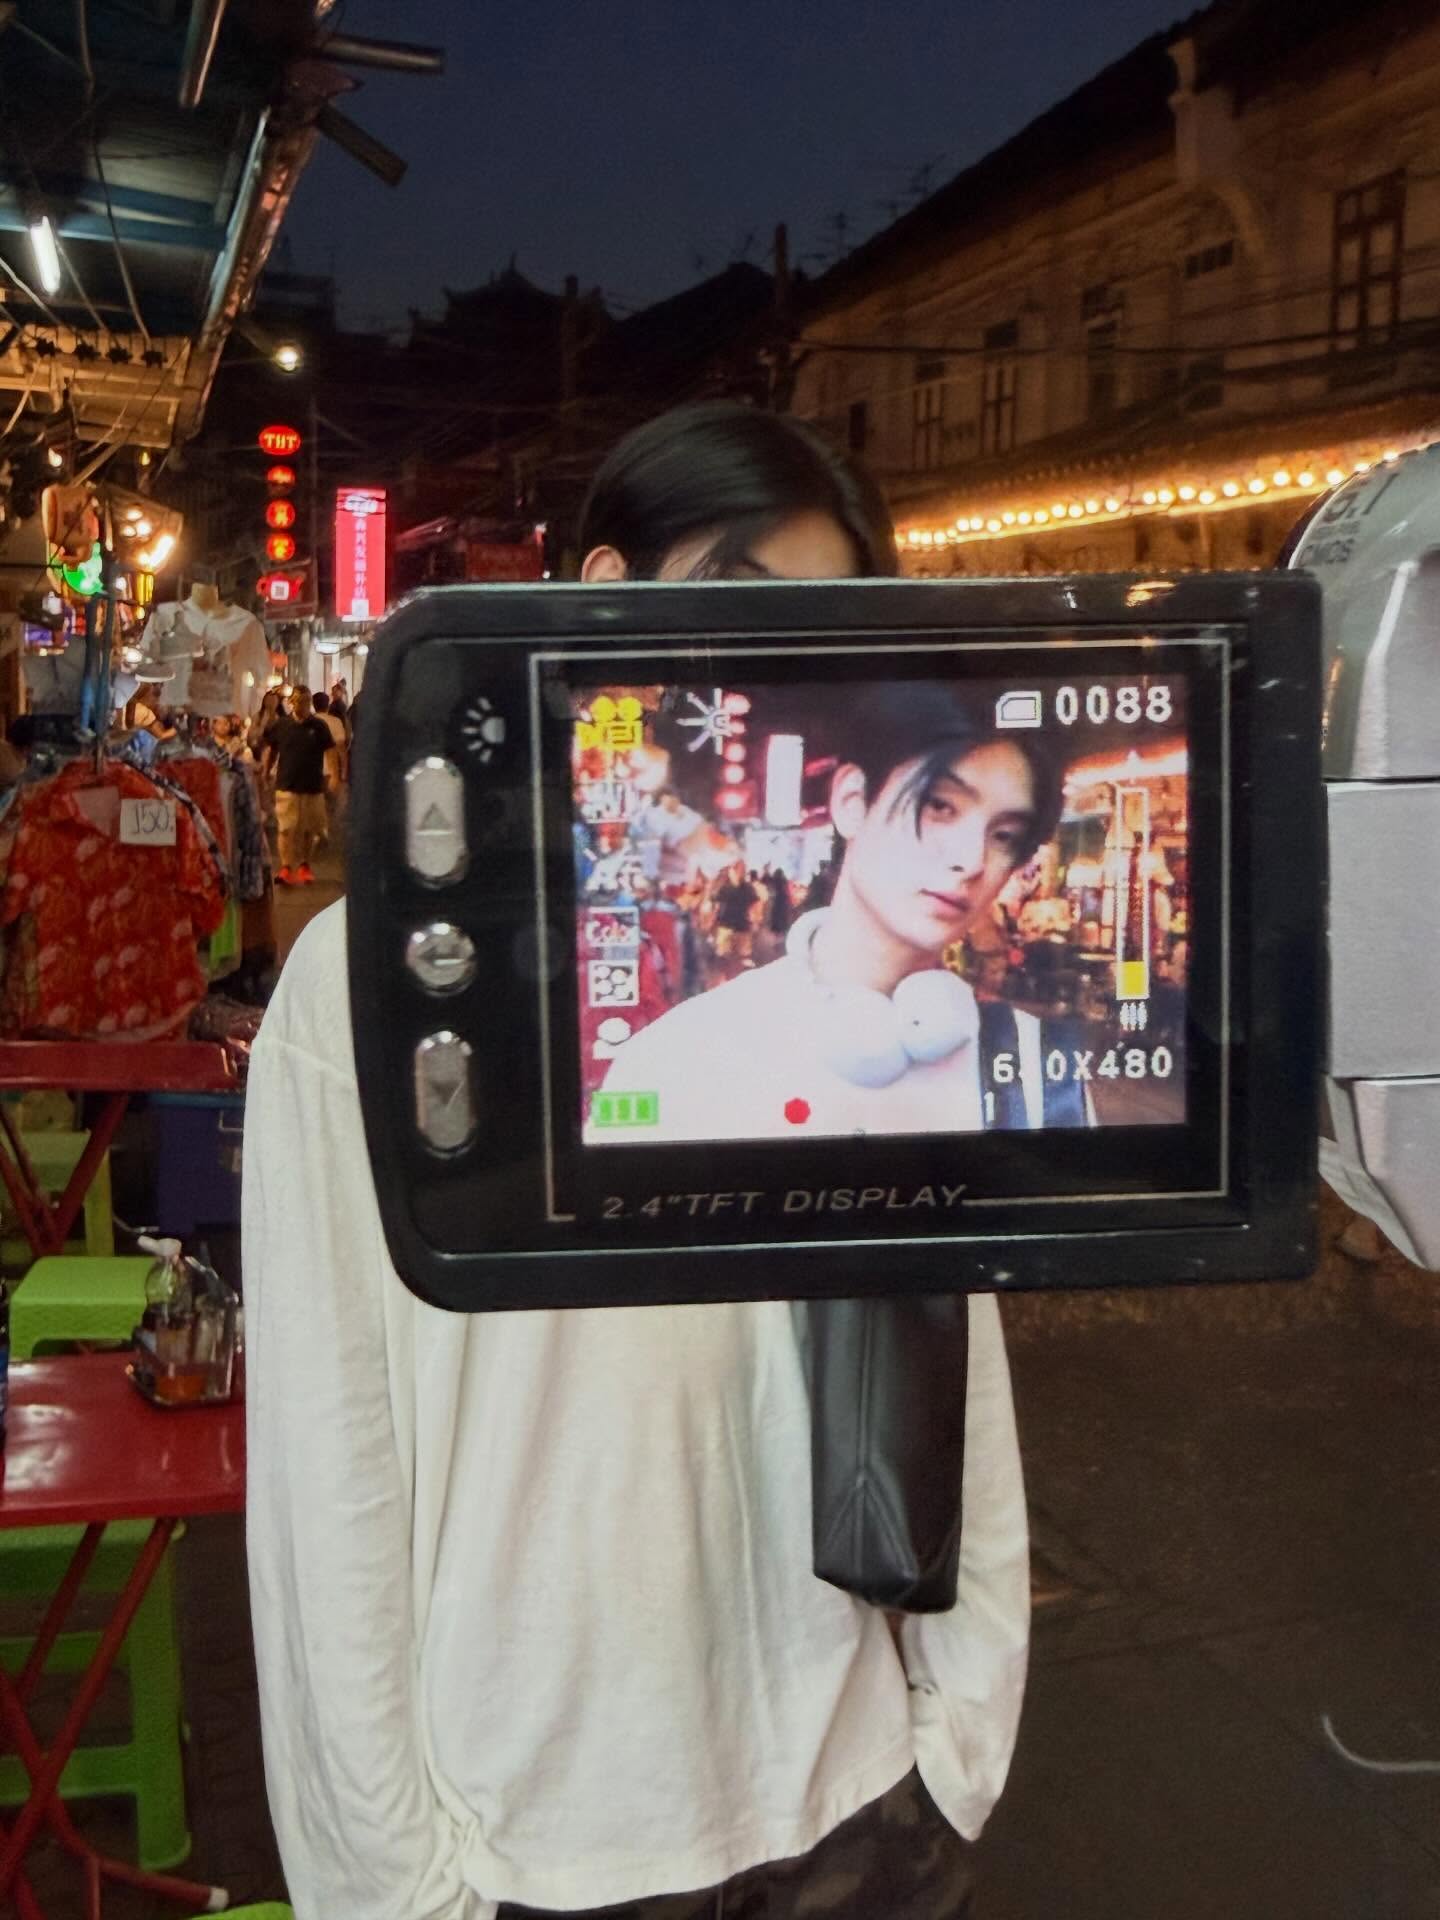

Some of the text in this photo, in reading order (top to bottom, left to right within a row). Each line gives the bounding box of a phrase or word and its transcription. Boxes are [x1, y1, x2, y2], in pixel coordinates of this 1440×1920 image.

[1056, 685, 1173, 726] 0088
[993, 1046, 1174, 1084] 60X480
[783, 1184, 968, 1214] DISPLAY
